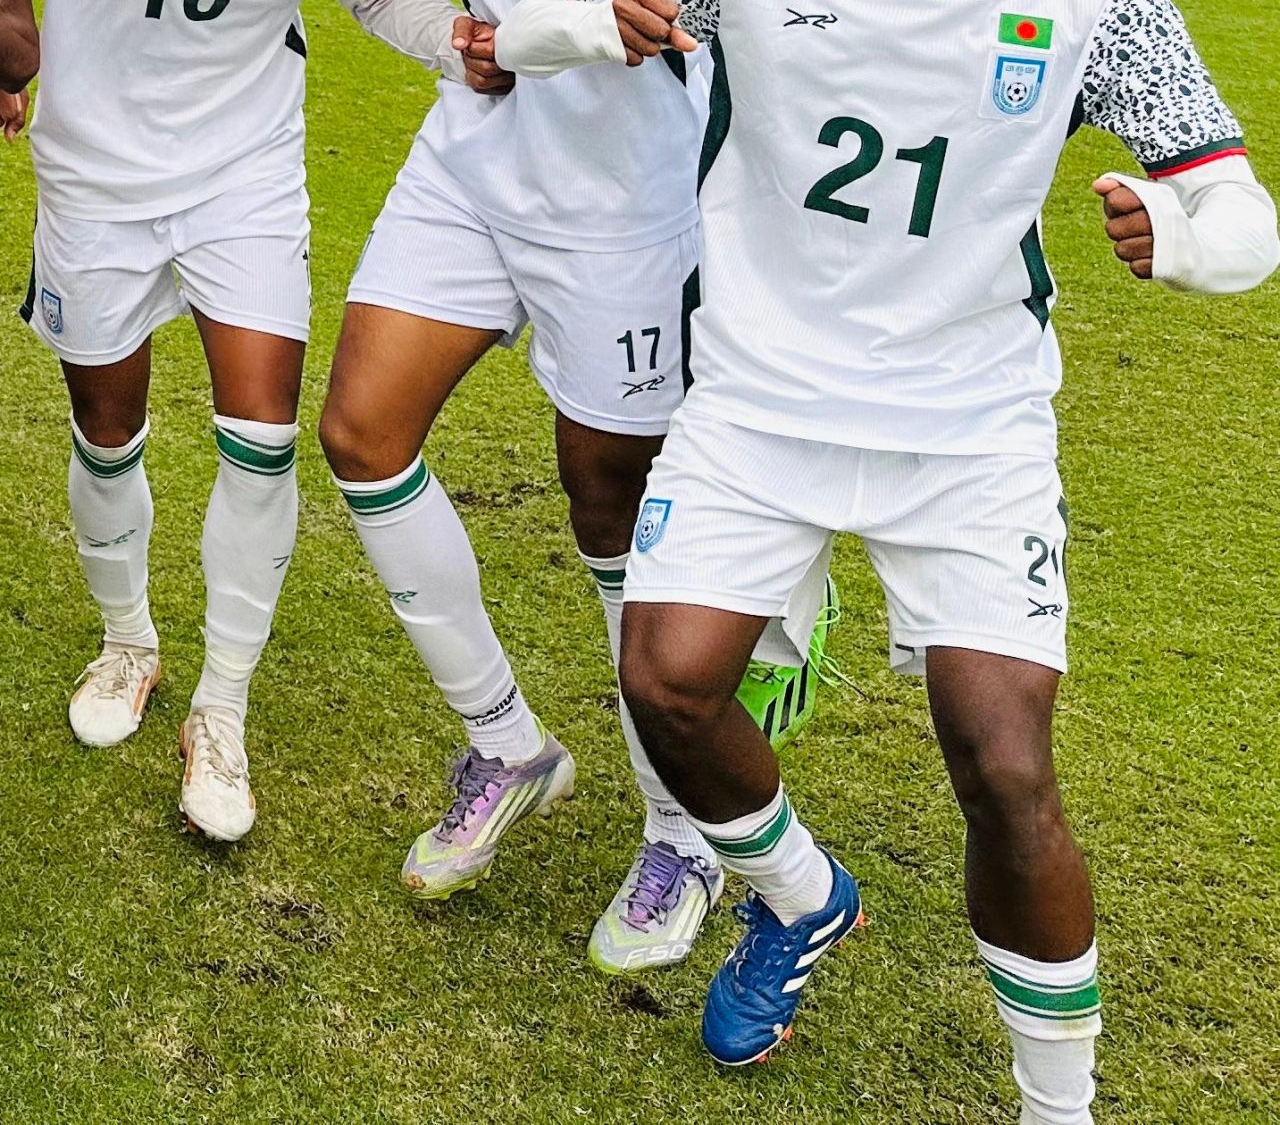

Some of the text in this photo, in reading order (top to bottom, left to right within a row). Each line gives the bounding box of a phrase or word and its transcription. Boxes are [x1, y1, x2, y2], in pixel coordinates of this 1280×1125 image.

[804, 116, 949, 239] 21
[616, 326, 661, 373] 17
[622, 943, 688, 971] F50
